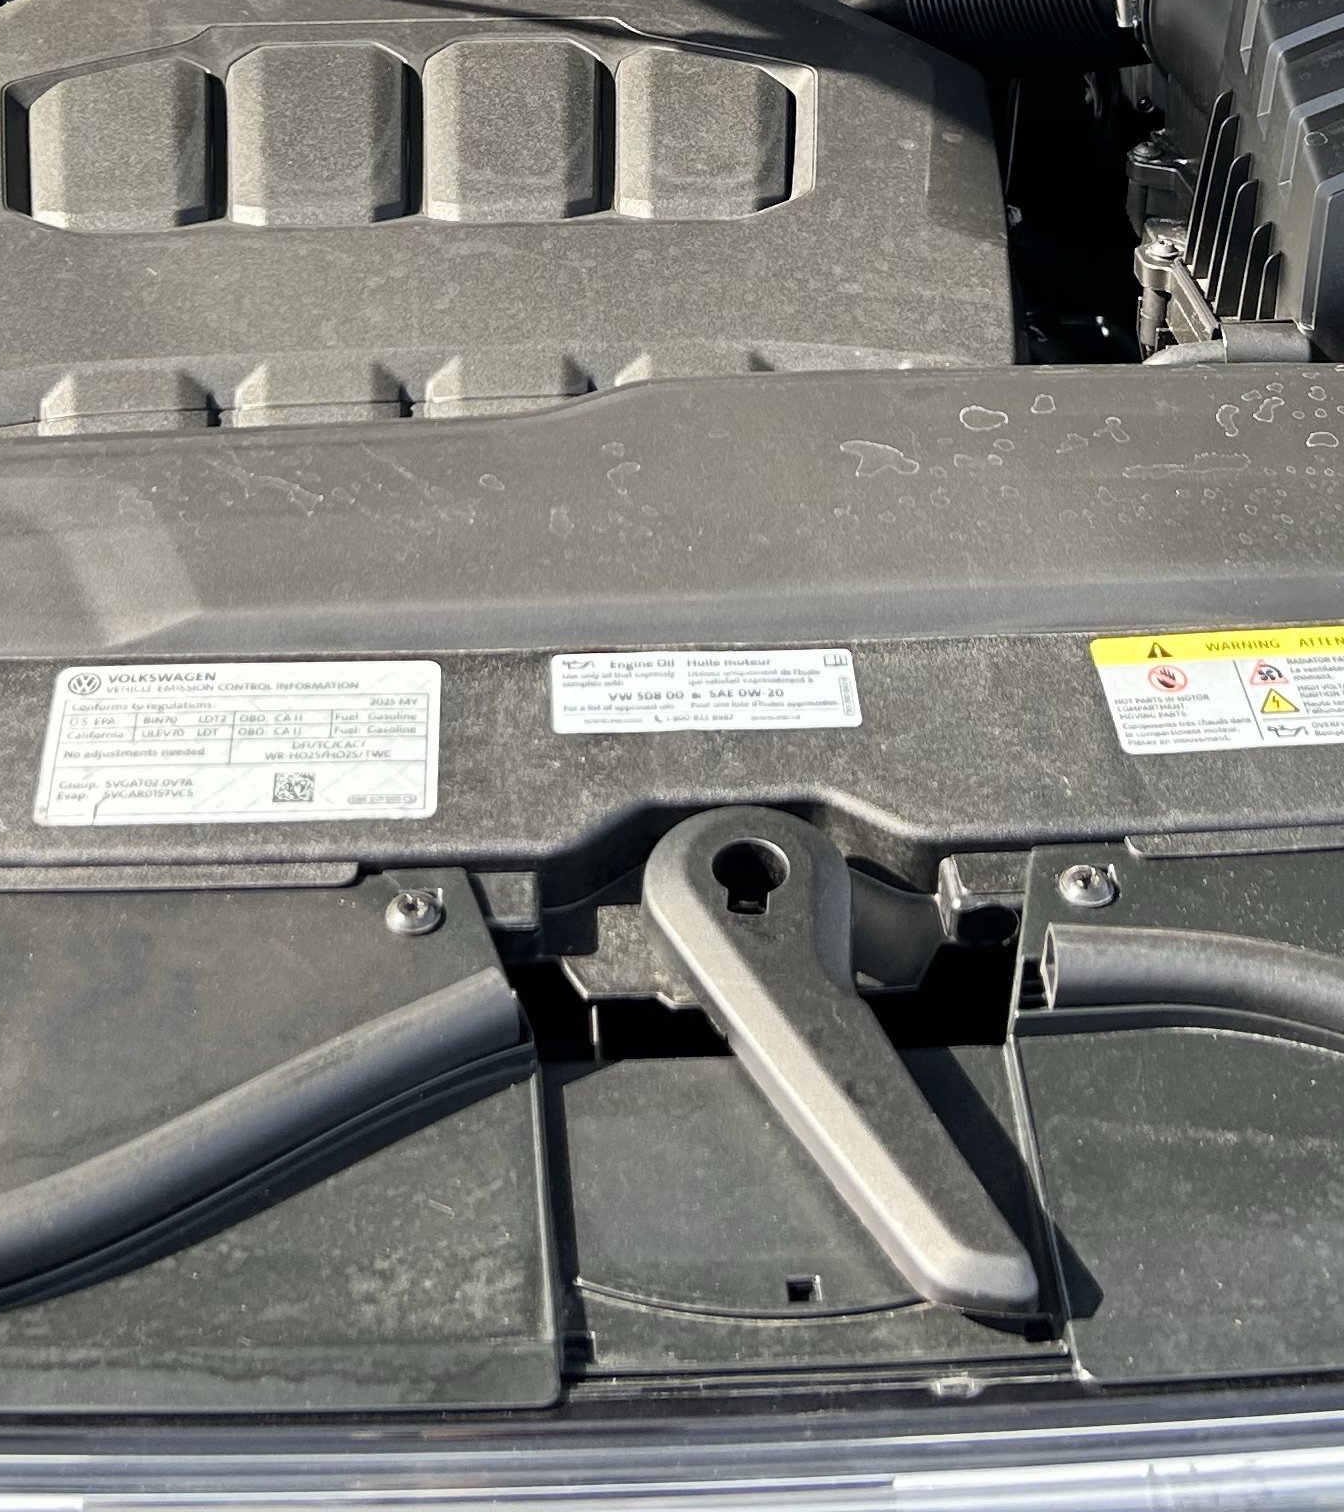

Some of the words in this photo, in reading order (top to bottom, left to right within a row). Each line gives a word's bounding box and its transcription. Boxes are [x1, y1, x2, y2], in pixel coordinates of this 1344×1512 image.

[1206, 638, 1280, 652] WARNING
[610, 659, 653, 671] Engine
[657, 659, 675, 668] Oil
[687, 658, 720, 667] Huile
[724, 658, 770, 666] moteur
[108, 672, 216, 683] VOLKSWAGEN
[107, 685, 151, 693] VEHICLE
[157, 684, 214, 692] EMISSION
[218, 682, 272, 691] CONTROL
[276, 681, 359, 690] INFORMATION
[608, 692, 632, 701] VW
[637, 692, 661, 700] 508
[666, 691, 684, 699] 00
[709, 689, 734, 698] SAE
[738, 688, 784, 697] 0W-20
[72, 703, 128, 712] Conforms
[132, 702, 144, 711] to
[370, 697, 395, 706] 2025
[368, 711, 417, 721] Gasoline
[367, 725, 417, 735] Gasoline
[63, 750, 81, 759] No
[83, 748, 158, 760] adjustments
[161, 747, 205, 758] needed
